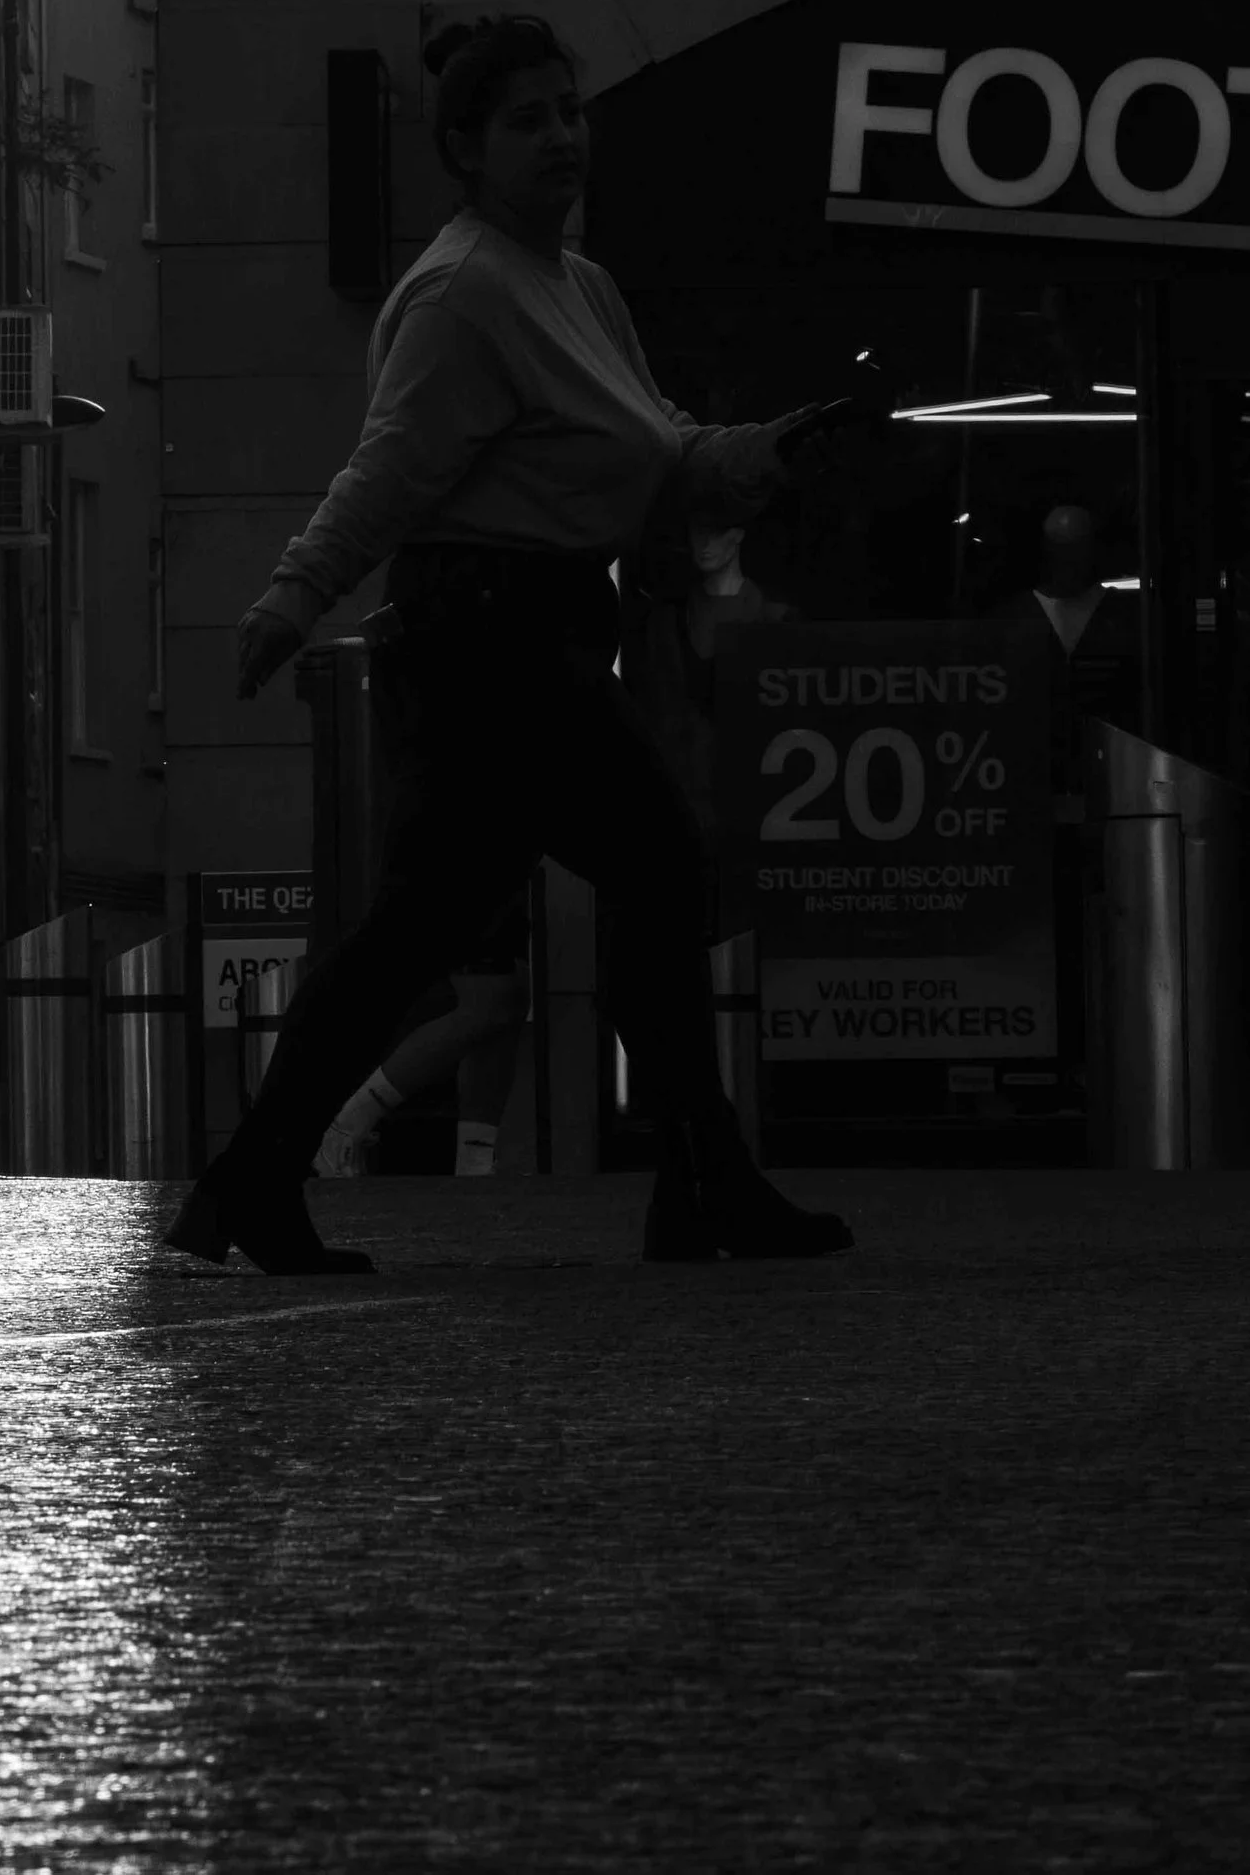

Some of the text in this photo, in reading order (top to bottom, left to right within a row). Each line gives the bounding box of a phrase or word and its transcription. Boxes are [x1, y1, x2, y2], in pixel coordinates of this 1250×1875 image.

[829, 42, 1250, 218] FOO
[757, 665, 1008, 706] STUDENTS
[934, 807, 1008, 838] OFF
[756, 865, 1015, 890] STUDENT DISCOUNT
[217, 887, 266, 910] THE
[905, 893, 968, 912] TODAY
[817, 979, 959, 1001] VALID FOR
[832, 1006, 1036, 1038] WORKERS
